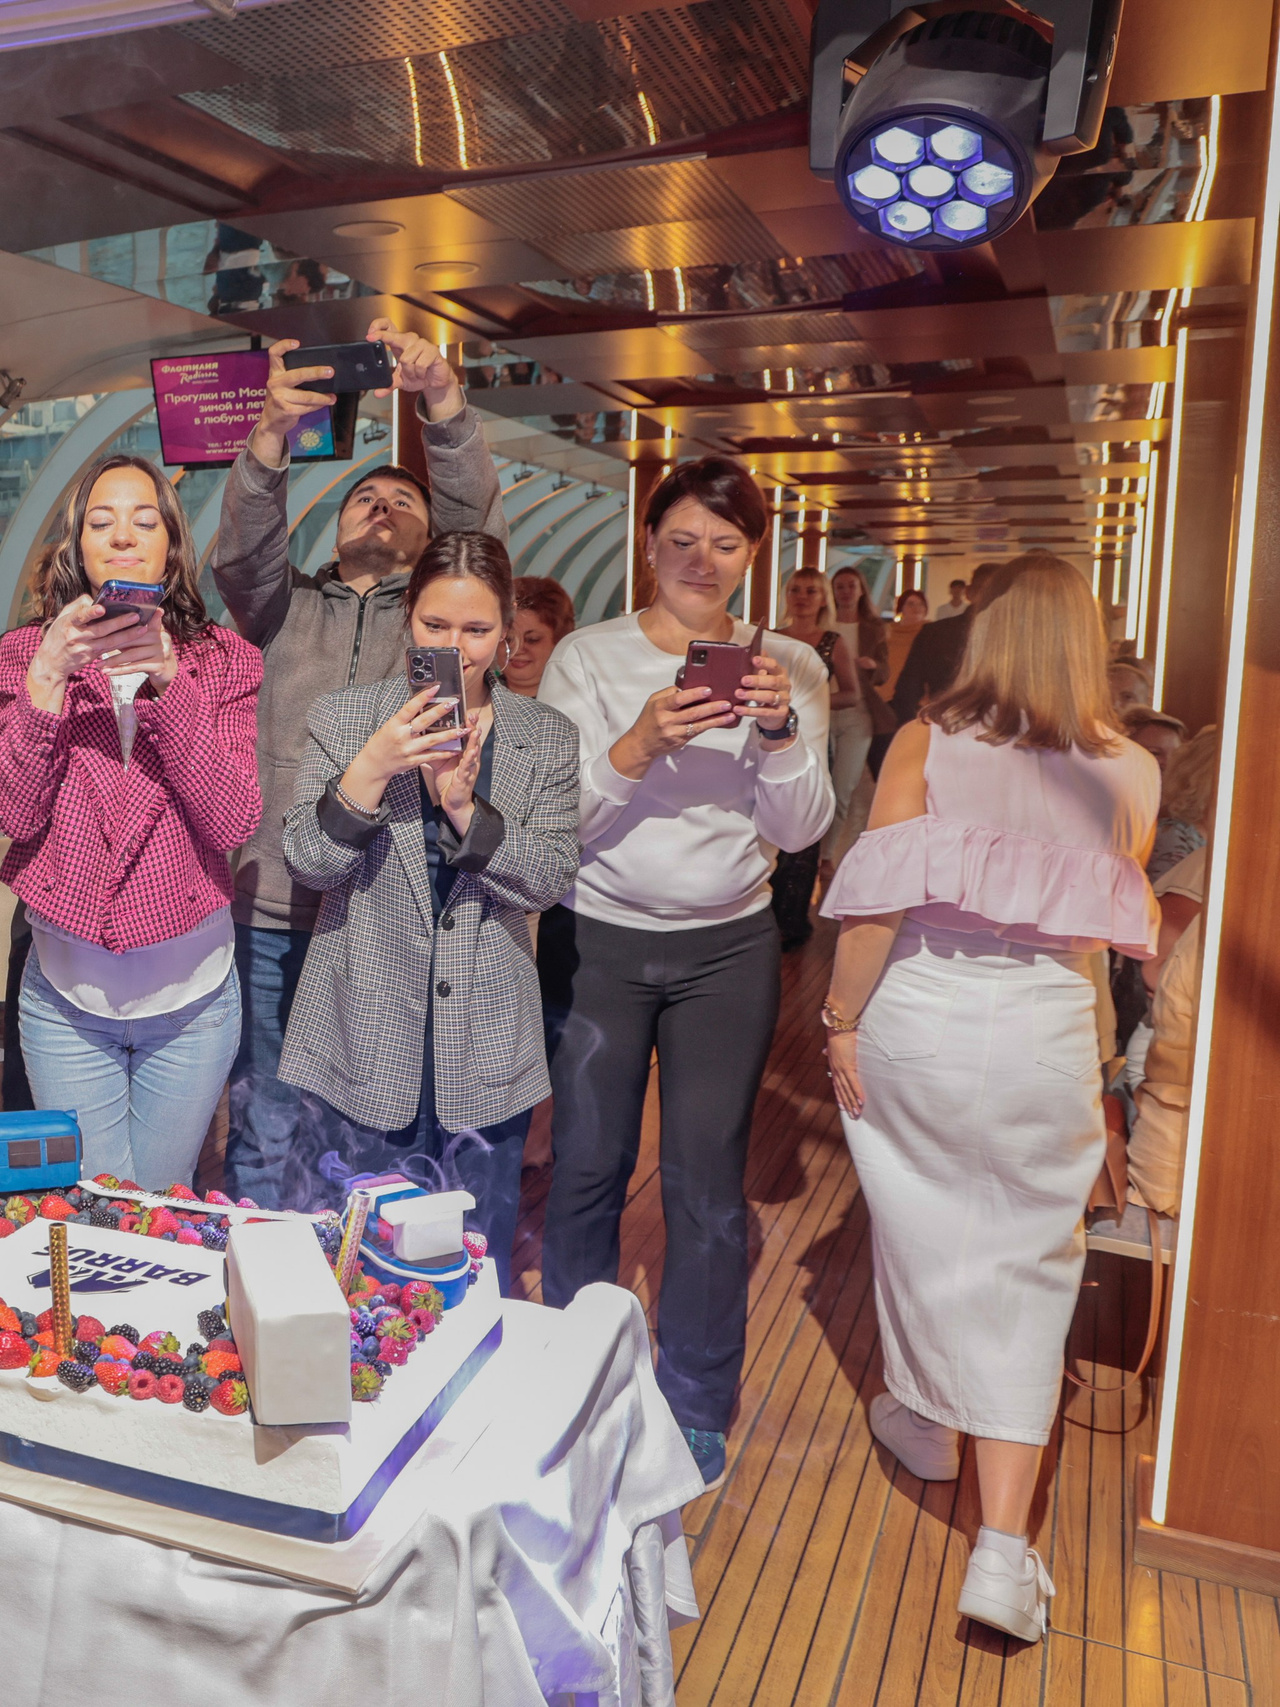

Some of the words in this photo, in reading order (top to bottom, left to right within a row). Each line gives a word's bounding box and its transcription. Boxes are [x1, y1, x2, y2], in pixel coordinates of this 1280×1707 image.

[180, 369, 219, 385] Radisson
[164, 392, 218, 406] Прогулки
[221, 390, 236, 400] по
[199, 401, 233, 413] зимой
[235, 402, 243, 411] и
[194, 417, 201, 425] в
[204, 412, 244, 425] любую
[31, 1245, 212, 1287] BARRUS
